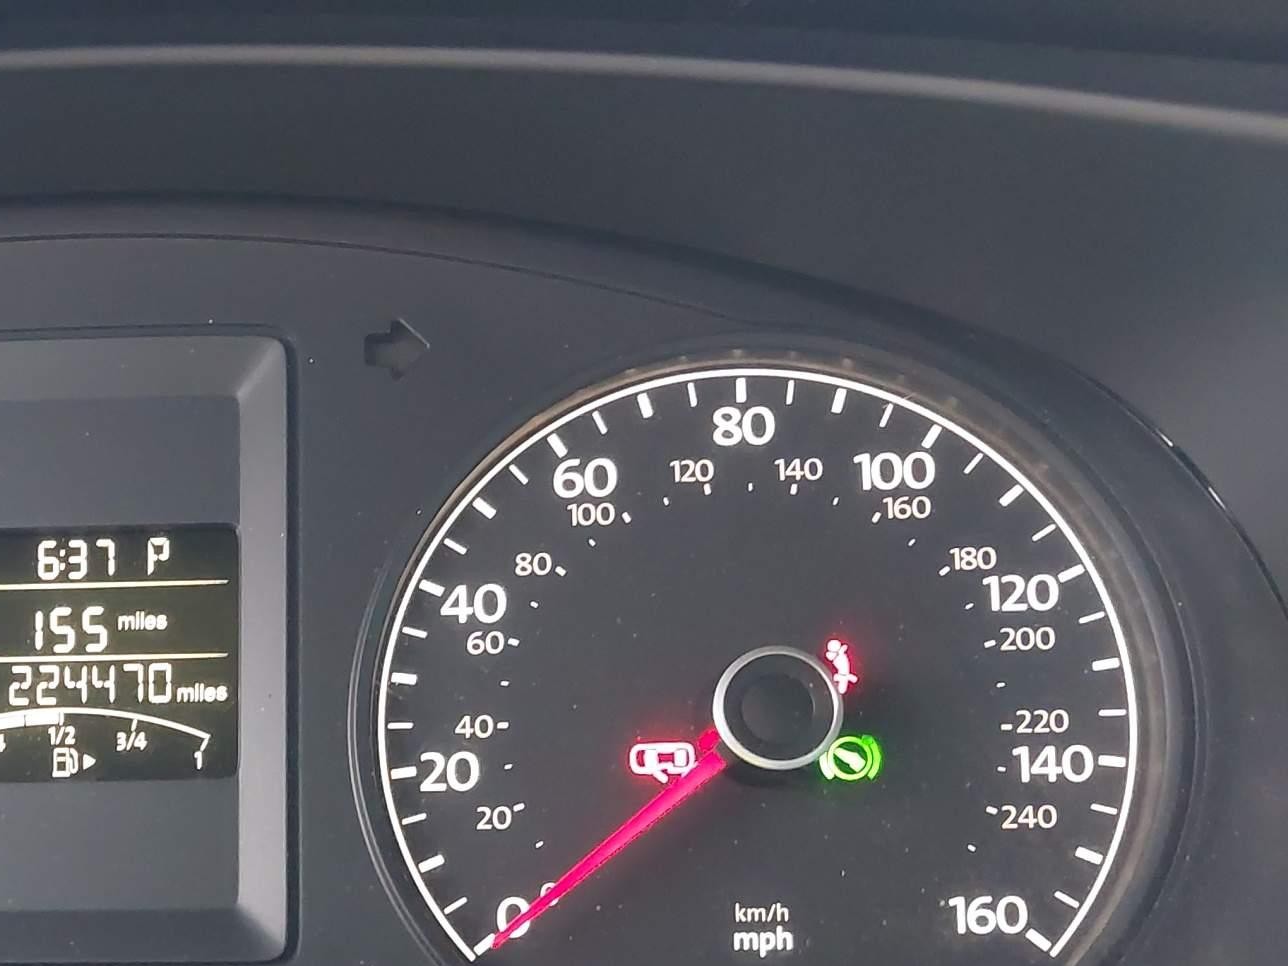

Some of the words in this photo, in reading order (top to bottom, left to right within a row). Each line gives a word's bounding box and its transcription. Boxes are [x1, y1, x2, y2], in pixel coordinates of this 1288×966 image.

[712, 405, 776, 447] 80
[552, 457, 618, 499] 60
[669, 459, 715, 483] 120
[774, 457, 824, 482] 140
[853, 451, 936, 491] 100
[566, 502, 616, 527] 100
[882, 495, 932, 520] 160
[37, 538, 116, 581] 6:37
[147, 536, 170, 576] P
[515, 552, 552, 577] 80
[949, 546, 997, 571] 180
[439, 583, 508, 624] 40
[982, 573, 1060, 612] 120
[34, 605, 109, 654] 155
[117, 610, 168, 631] miles
[999, 626, 1056, 651] 200
[466, 630, 505, 655] 60
[8, 662, 172, 706] 224470
[176, 682, 228, 703] miles
[454, 714, 494, 739] 40
[1015, 709, 1070, 734] 220
[47, 725, 76, 746] 1/2
[116, 731, 148, 752] 3/4
[194, 751, 203, 770] 1
[419, 750, 480, 792] 20
[1011, 744, 1095, 783] 140
[476, 805, 512, 830] 20
[1001, 804, 1058, 830] 240
[496, 896, 532, 939] 0
[735, 902, 789, 923] km/h
[948, 895, 1029, 936] 160
[733, 925, 794, 958] mph
